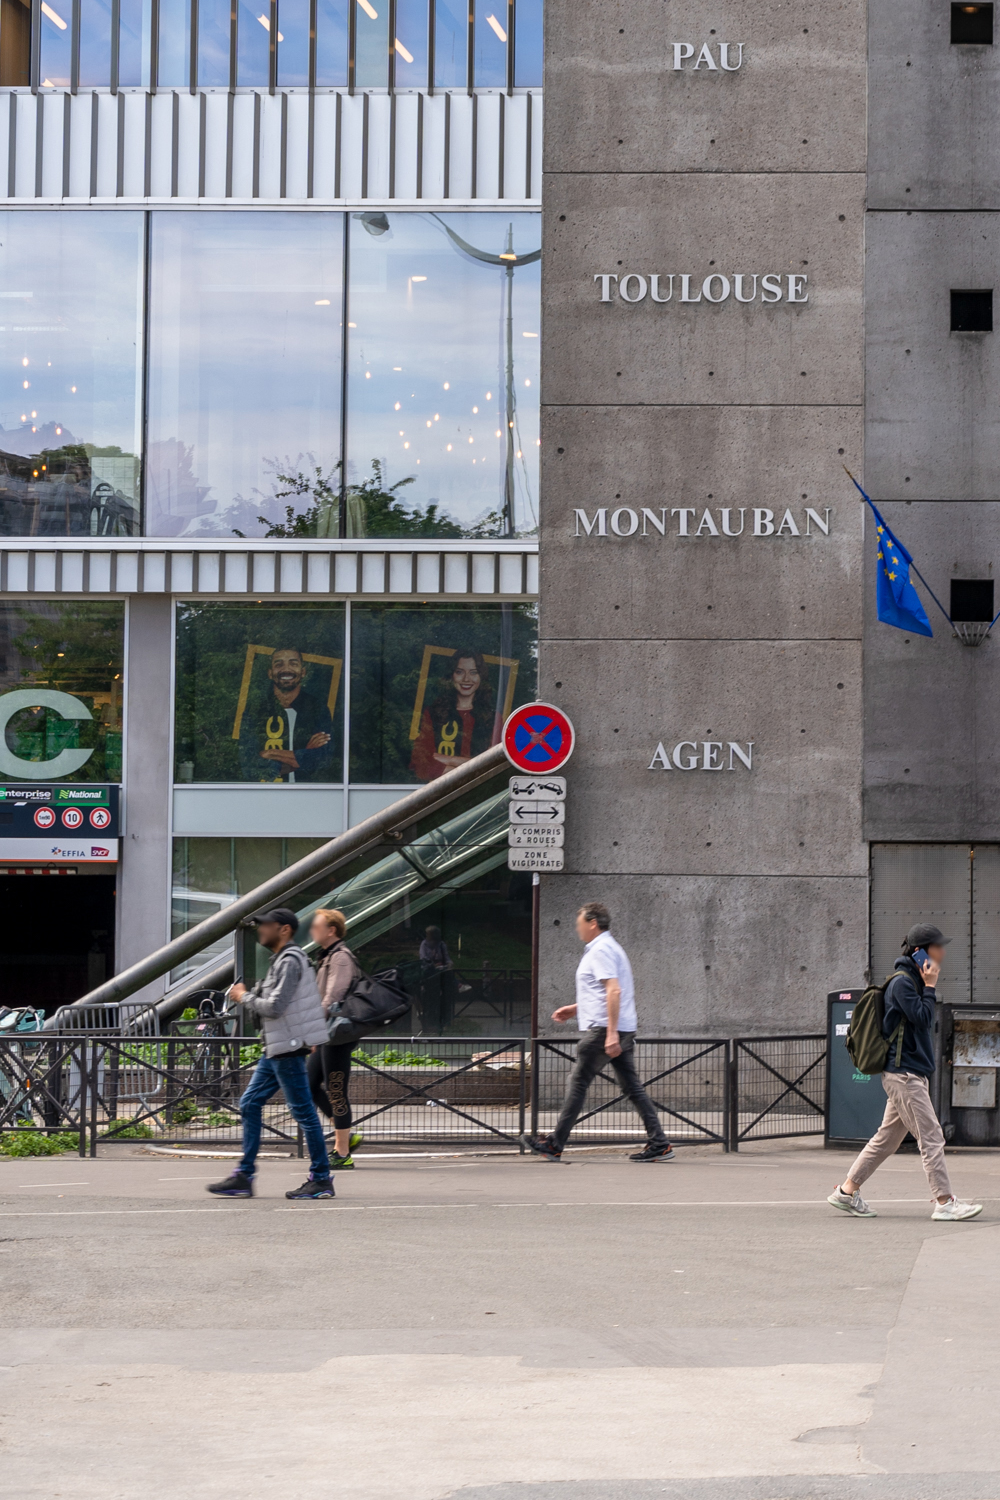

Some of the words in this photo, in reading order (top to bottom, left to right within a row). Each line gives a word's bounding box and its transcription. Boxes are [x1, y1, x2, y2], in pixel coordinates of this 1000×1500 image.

[671, 42, 745, 71] PAU
[594, 273, 809, 303] TOULOUSE
[573, 507, 832, 537] MONTAUBAN
[648, 741, 754, 770] AGEN
[0, 790, 51, 799] enterprise
[68, 791, 102, 799] National
[68, 813, 78, 822] 10
[527, 836, 556, 844] ROUES
[524, 851, 548, 859] ZONE
